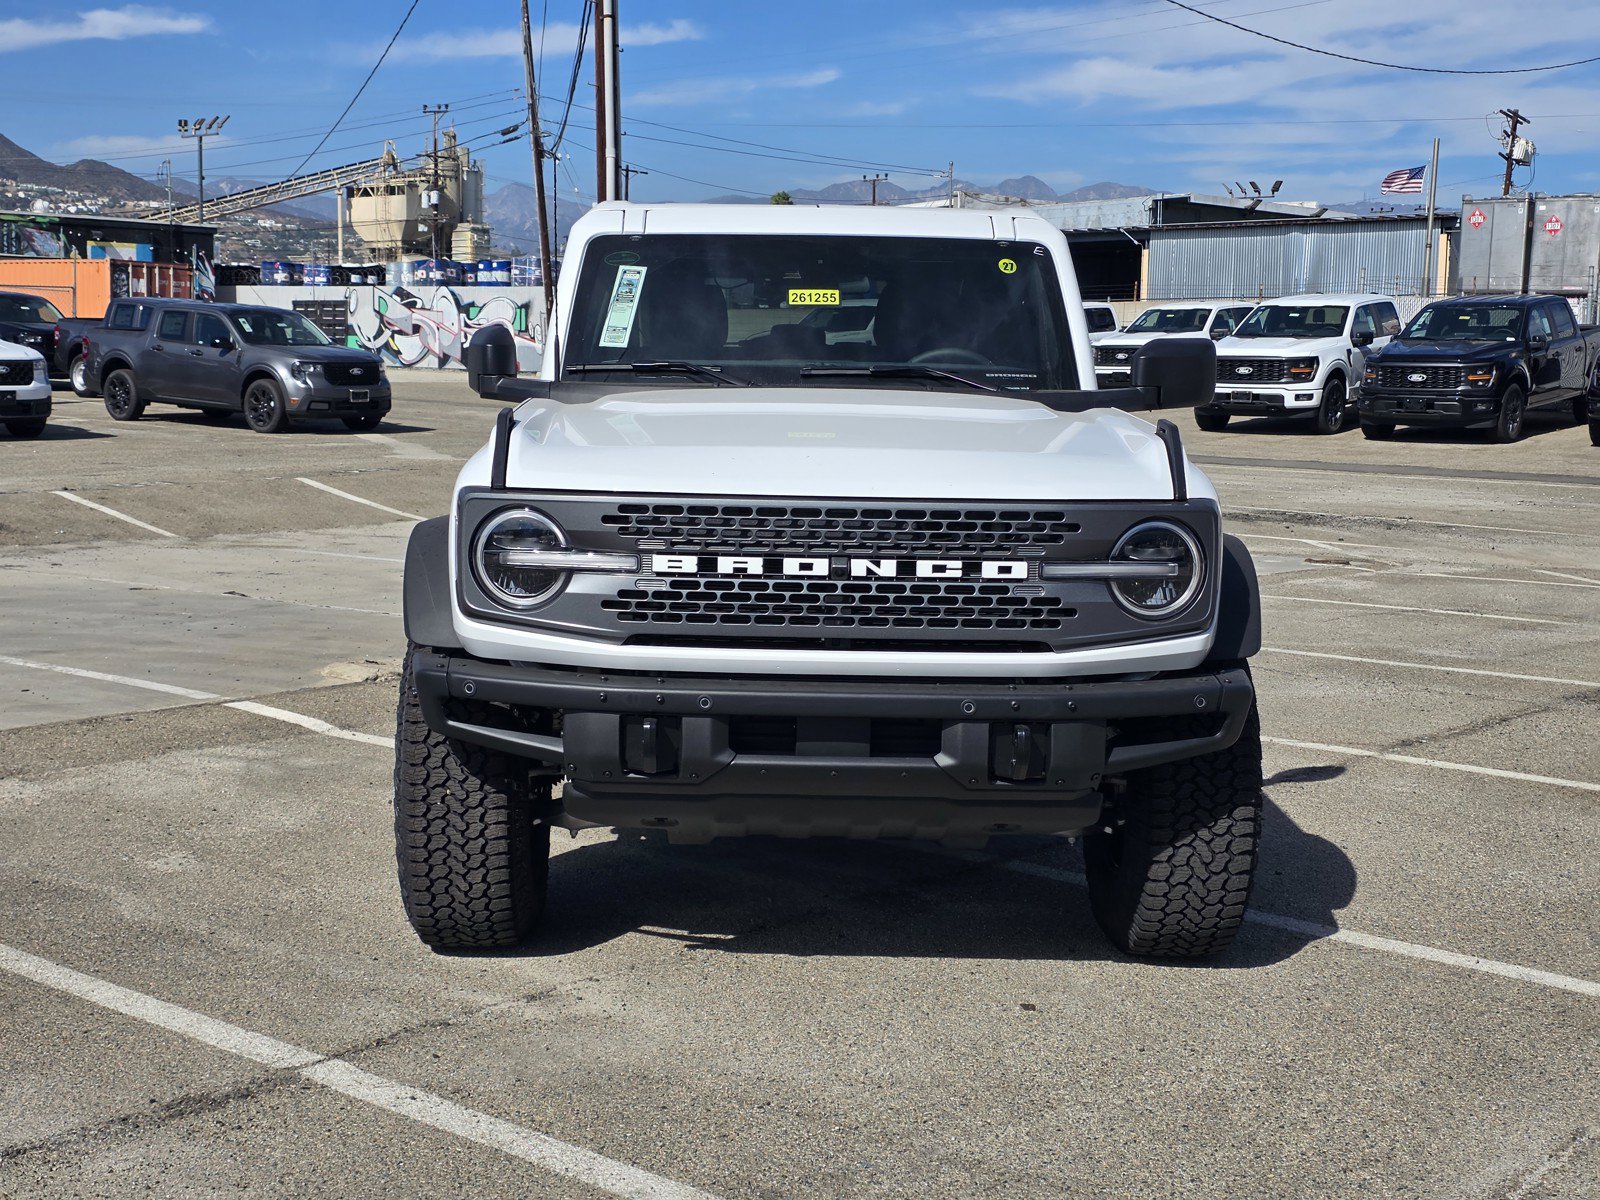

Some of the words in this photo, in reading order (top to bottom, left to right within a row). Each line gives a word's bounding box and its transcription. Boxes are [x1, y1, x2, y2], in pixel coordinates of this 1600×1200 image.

[1002, 262, 1014, 271] 27
[791, 292, 837, 303] 261255
[652, 554, 1028, 580] BRONCO
